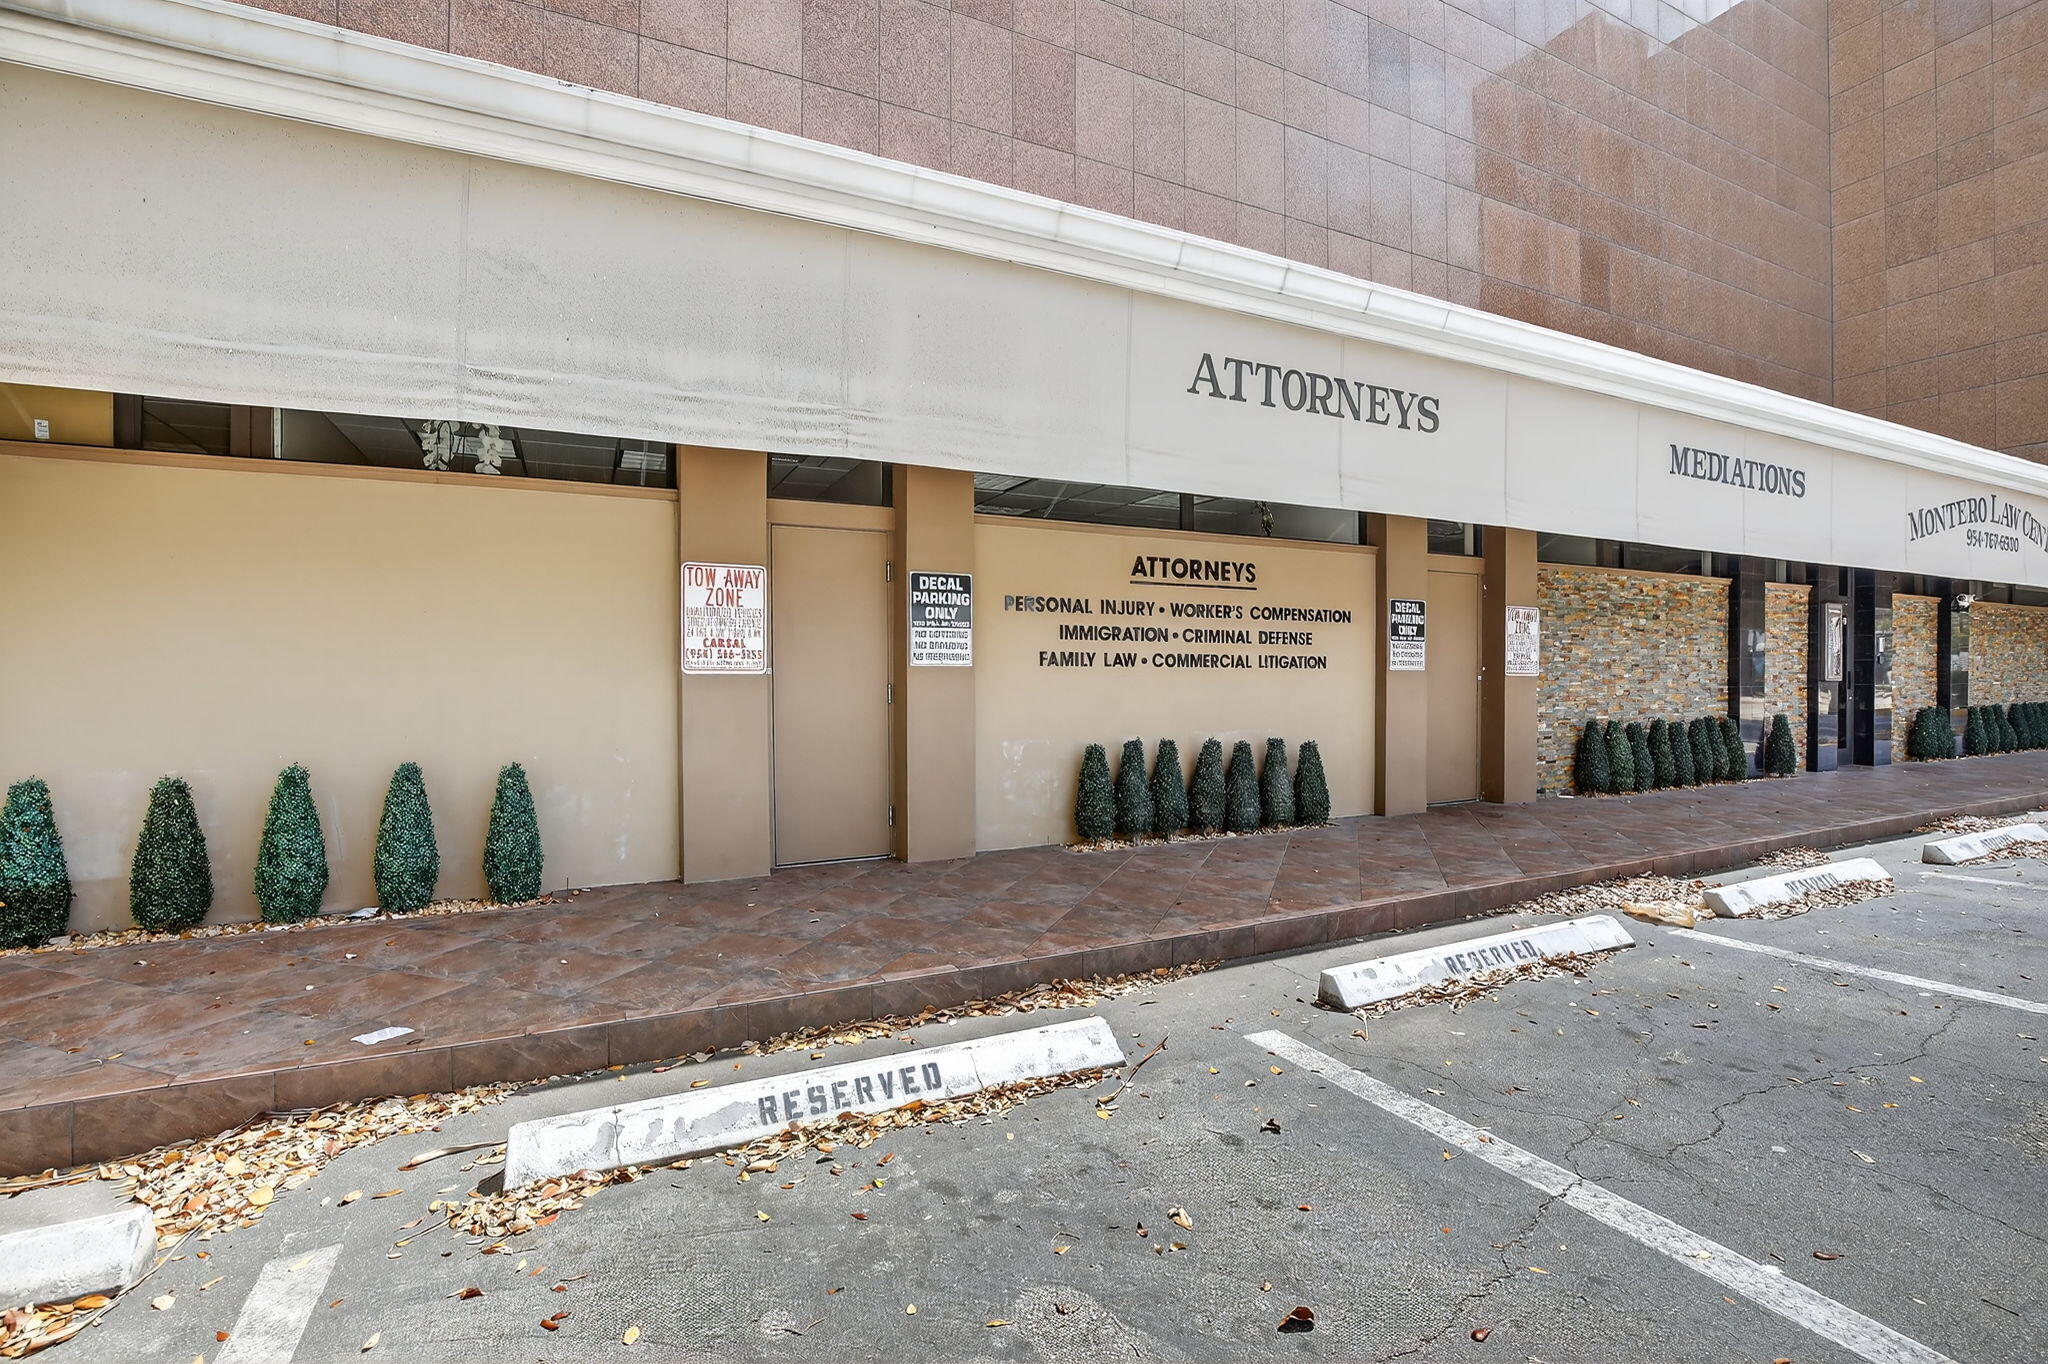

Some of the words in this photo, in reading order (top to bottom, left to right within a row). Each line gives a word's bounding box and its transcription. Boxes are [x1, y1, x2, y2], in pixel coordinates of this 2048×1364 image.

[1186, 352, 1440, 434] ATTORNEYS
[1669, 443, 1806, 498] MEDIATIONS
[1907, 497, 1987, 541] MONTERO
[1989, 494, 2021, 531] LAW
[686, 567, 716, 587] TOW
[724, 569, 762, 589] AWAY
[1130, 556, 1256, 583] ATTORNEYS
[919, 576, 963, 591] DECAL
[705, 587, 744, 607] ZONE
[912, 591, 970, 606] PARKING
[924, 606, 958, 620] ONLY
[1004, 595, 1093, 614] PERSONAL
[1100, 600, 1155, 617] INJURY
[1169, 603, 1243, 620] WORKER'S
[1250, 606, 1352, 624] COMPENSATION
[1059, 624, 1169, 643] IMMIGRATION
[1182, 628, 1252, 645] CRIMINAL
[1258, 630, 1313, 646] DEFENSE
[1039, 651, 1096, 668] FAMILY
[1104, 652, 1138, 668] LAW
[1152, 653, 1252, 669] COMMERCIAL
[1258, 654, 1327, 670] LITIGATION
[757, 1062, 943, 1126] RESERVED
